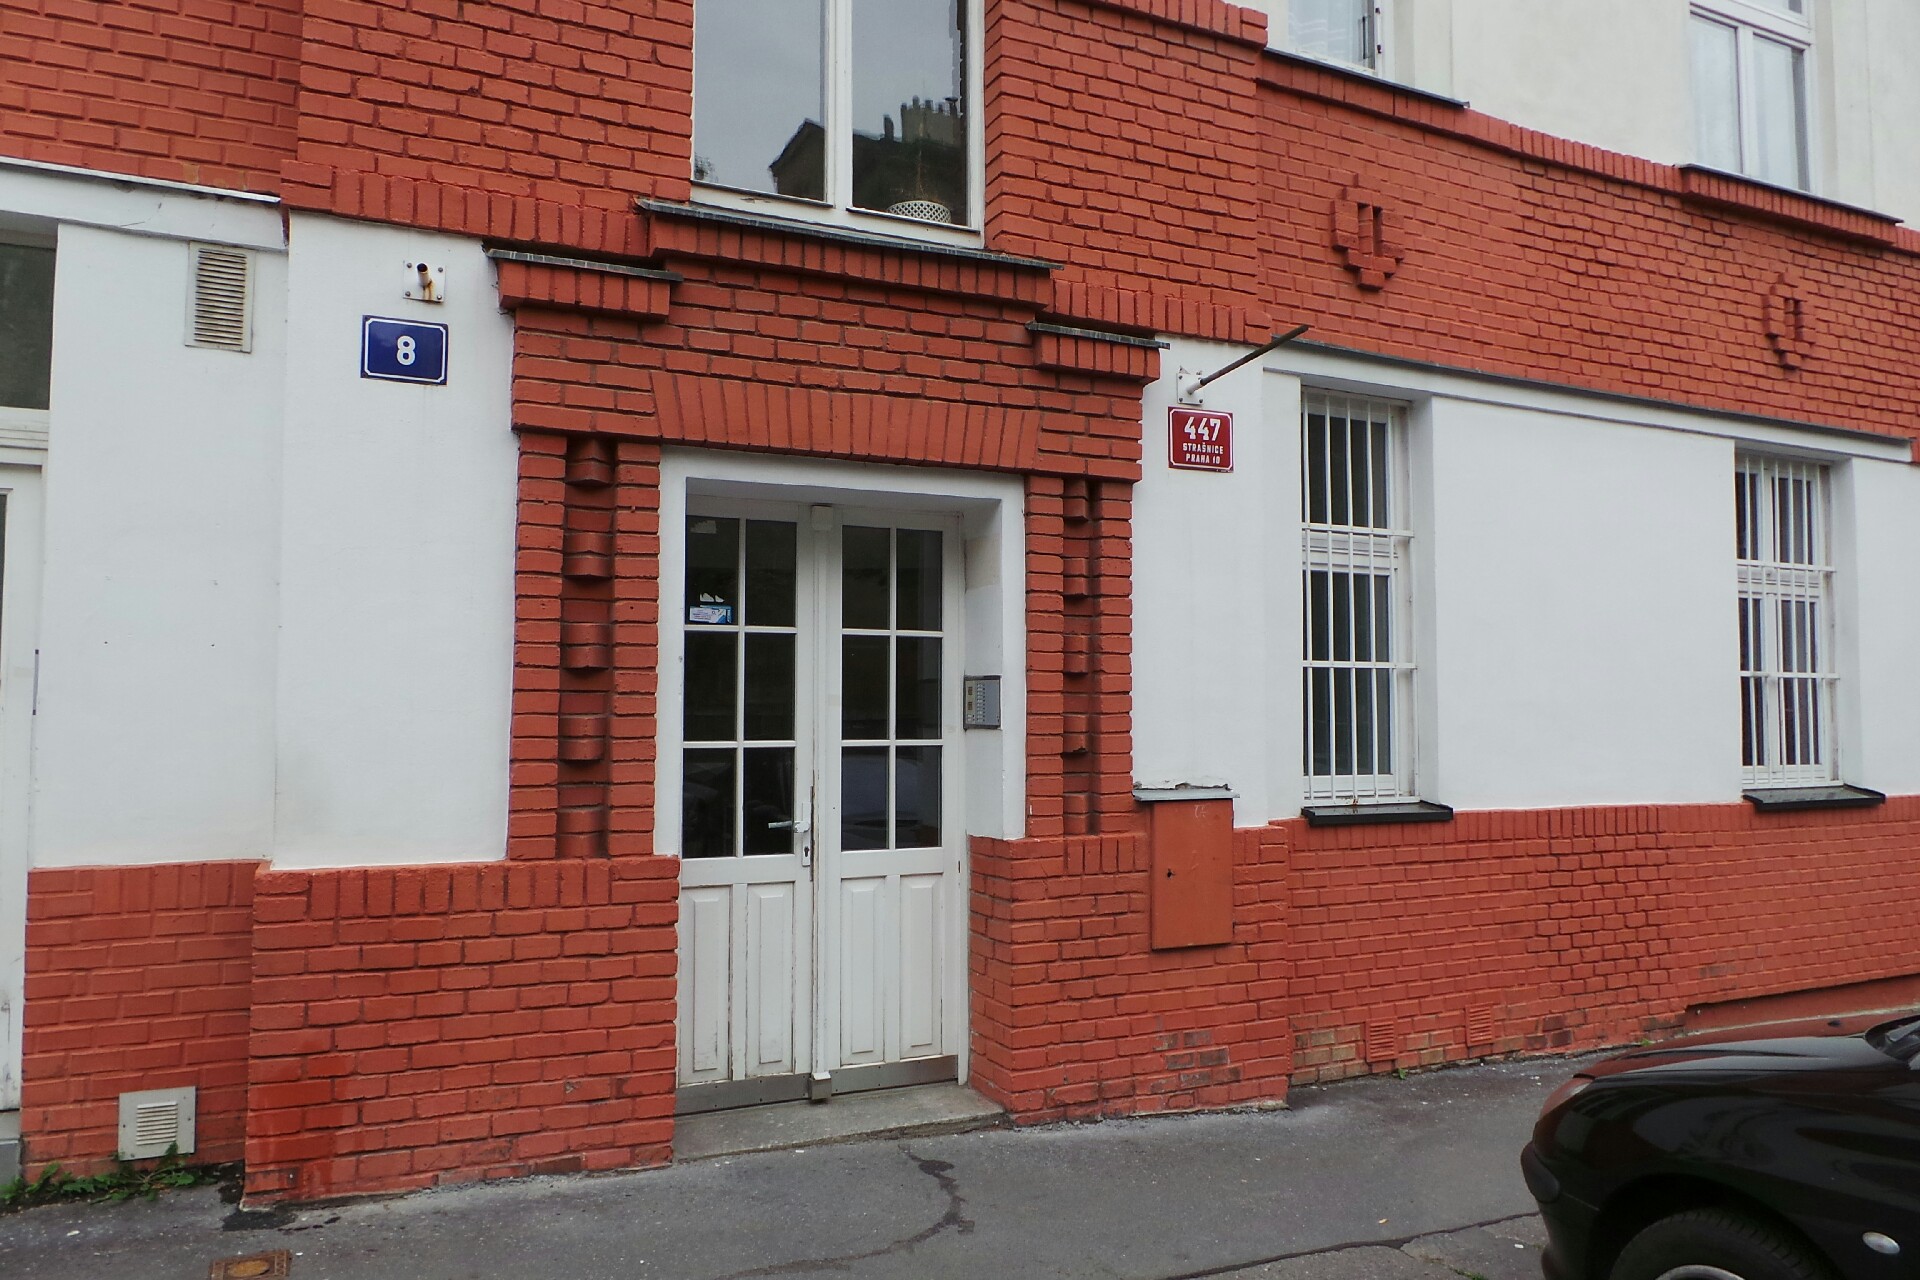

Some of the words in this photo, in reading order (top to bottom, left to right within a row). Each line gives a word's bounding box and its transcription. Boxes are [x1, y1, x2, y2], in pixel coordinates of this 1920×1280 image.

[396, 335, 416, 366] 8
[1184, 416, 1221, 441] 447
[1182, 442, 1224, 454] STRAŠNICE
[1185, 453, 1210, 463] PRAHA
[1212, 455, 1221, 464] 10
